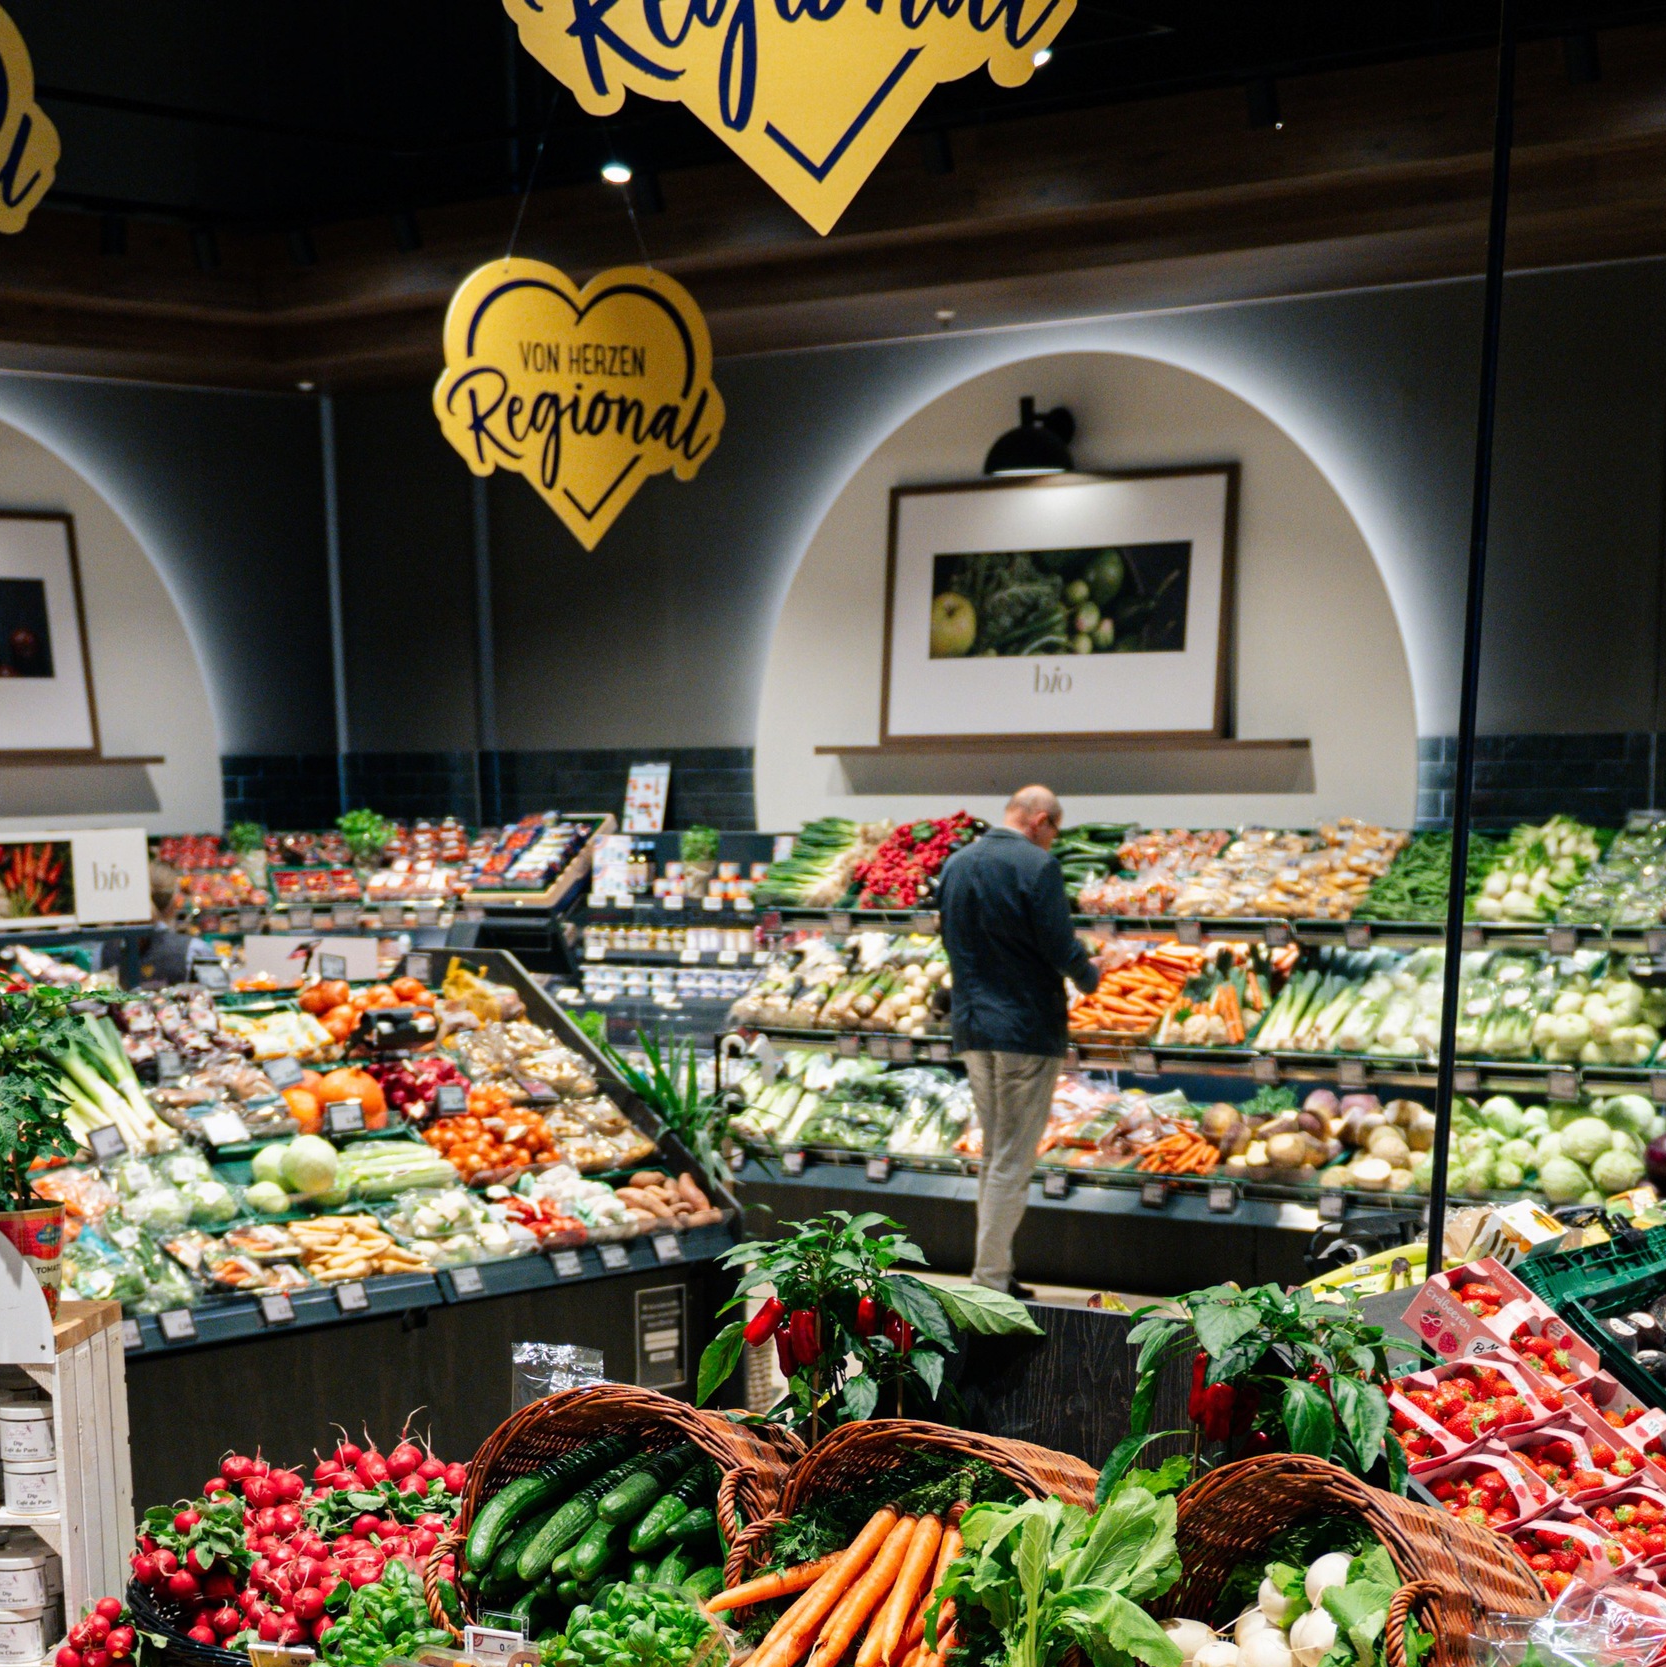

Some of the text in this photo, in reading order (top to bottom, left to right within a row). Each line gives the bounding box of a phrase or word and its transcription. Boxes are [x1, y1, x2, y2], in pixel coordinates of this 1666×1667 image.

[518, 341, 646, 378] VON HERZEN
[446, 366, 711, 490] Regional
[1033, 665, 1073, 694] bio
[92, 860, 130, 890] bio
[35, 1263, 63, 1275] TOMAT
[1425, 1285, 1472, 1334] Erdbeeren
